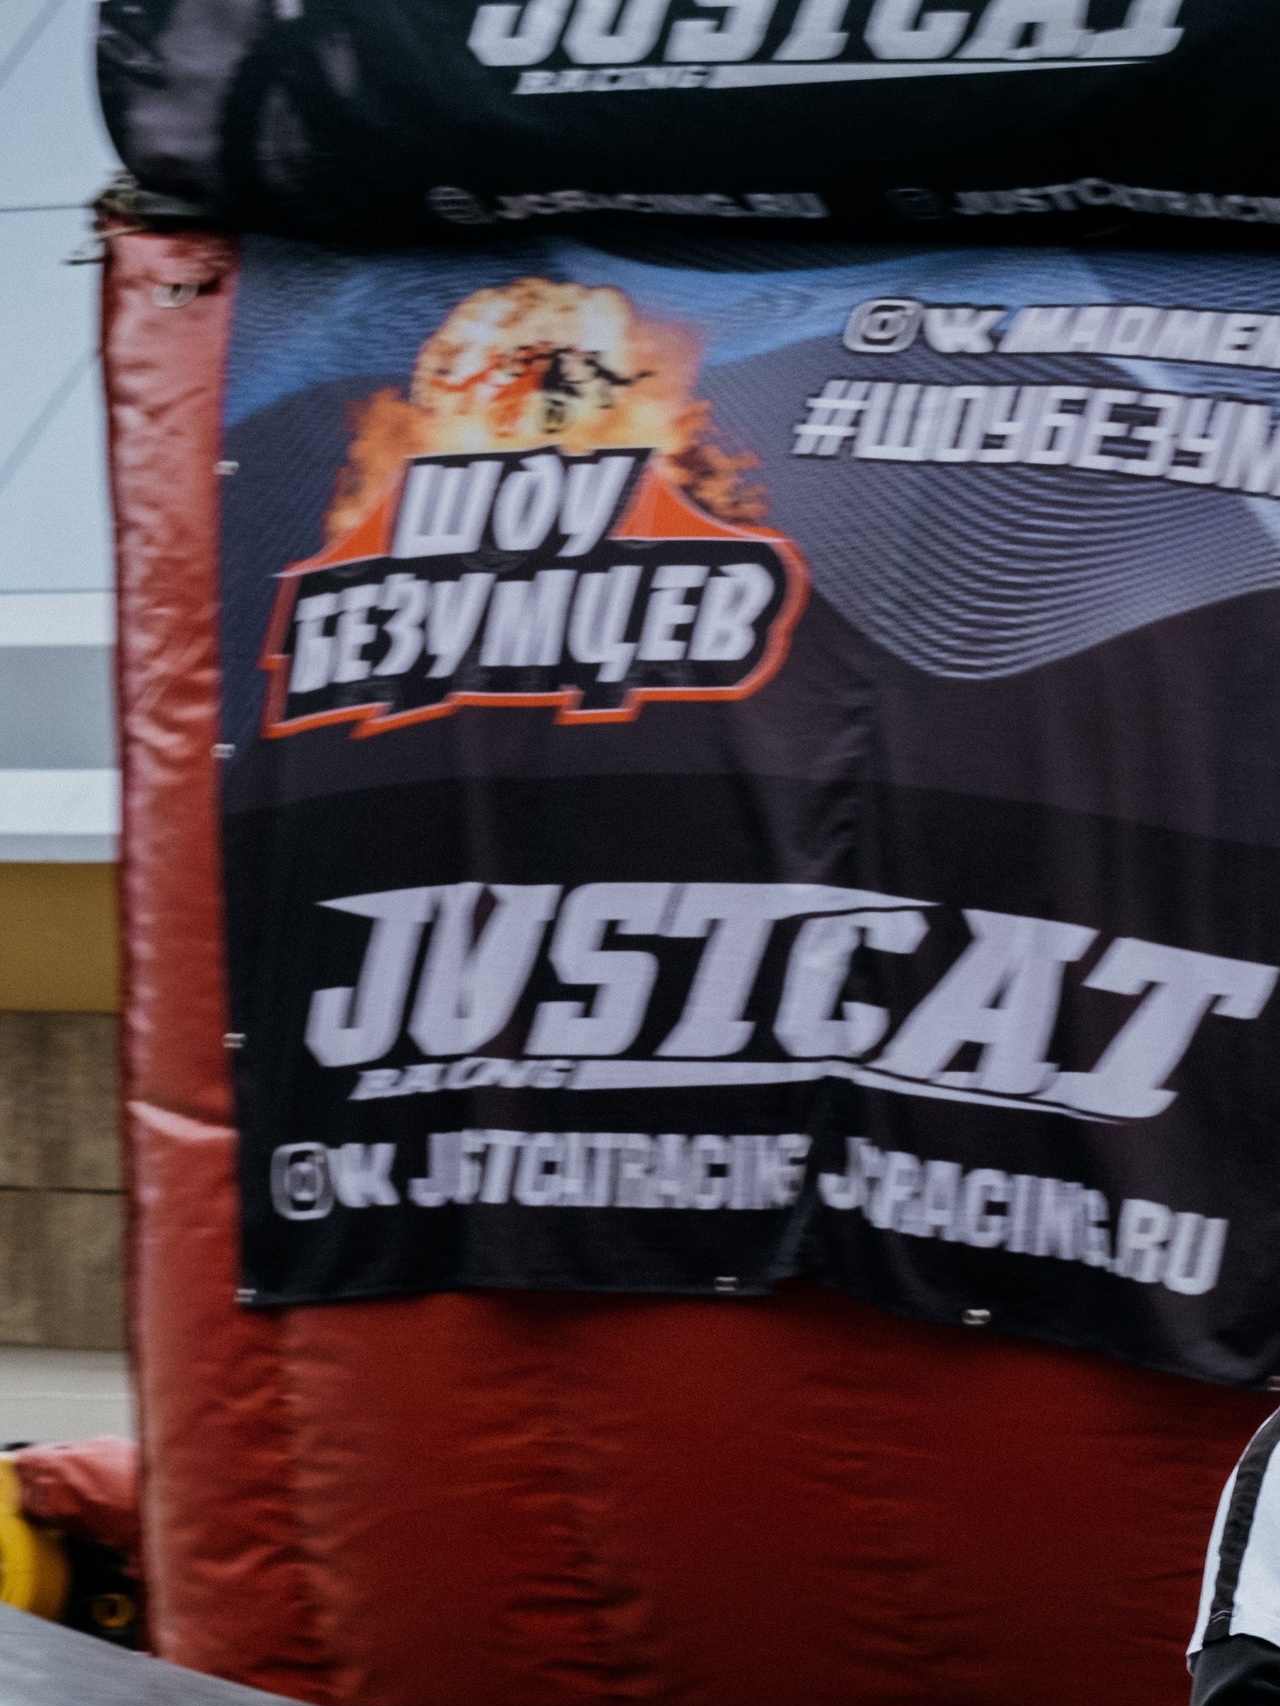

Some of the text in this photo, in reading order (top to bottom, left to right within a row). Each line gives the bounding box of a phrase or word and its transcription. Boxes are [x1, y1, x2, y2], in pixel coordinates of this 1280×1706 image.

[390, 452, 637, 558] ШОУ
[288, 562, 776, 694] БЕЗУМЦЕВ
[306, 882, 1280, 1121] JUSTCAT
